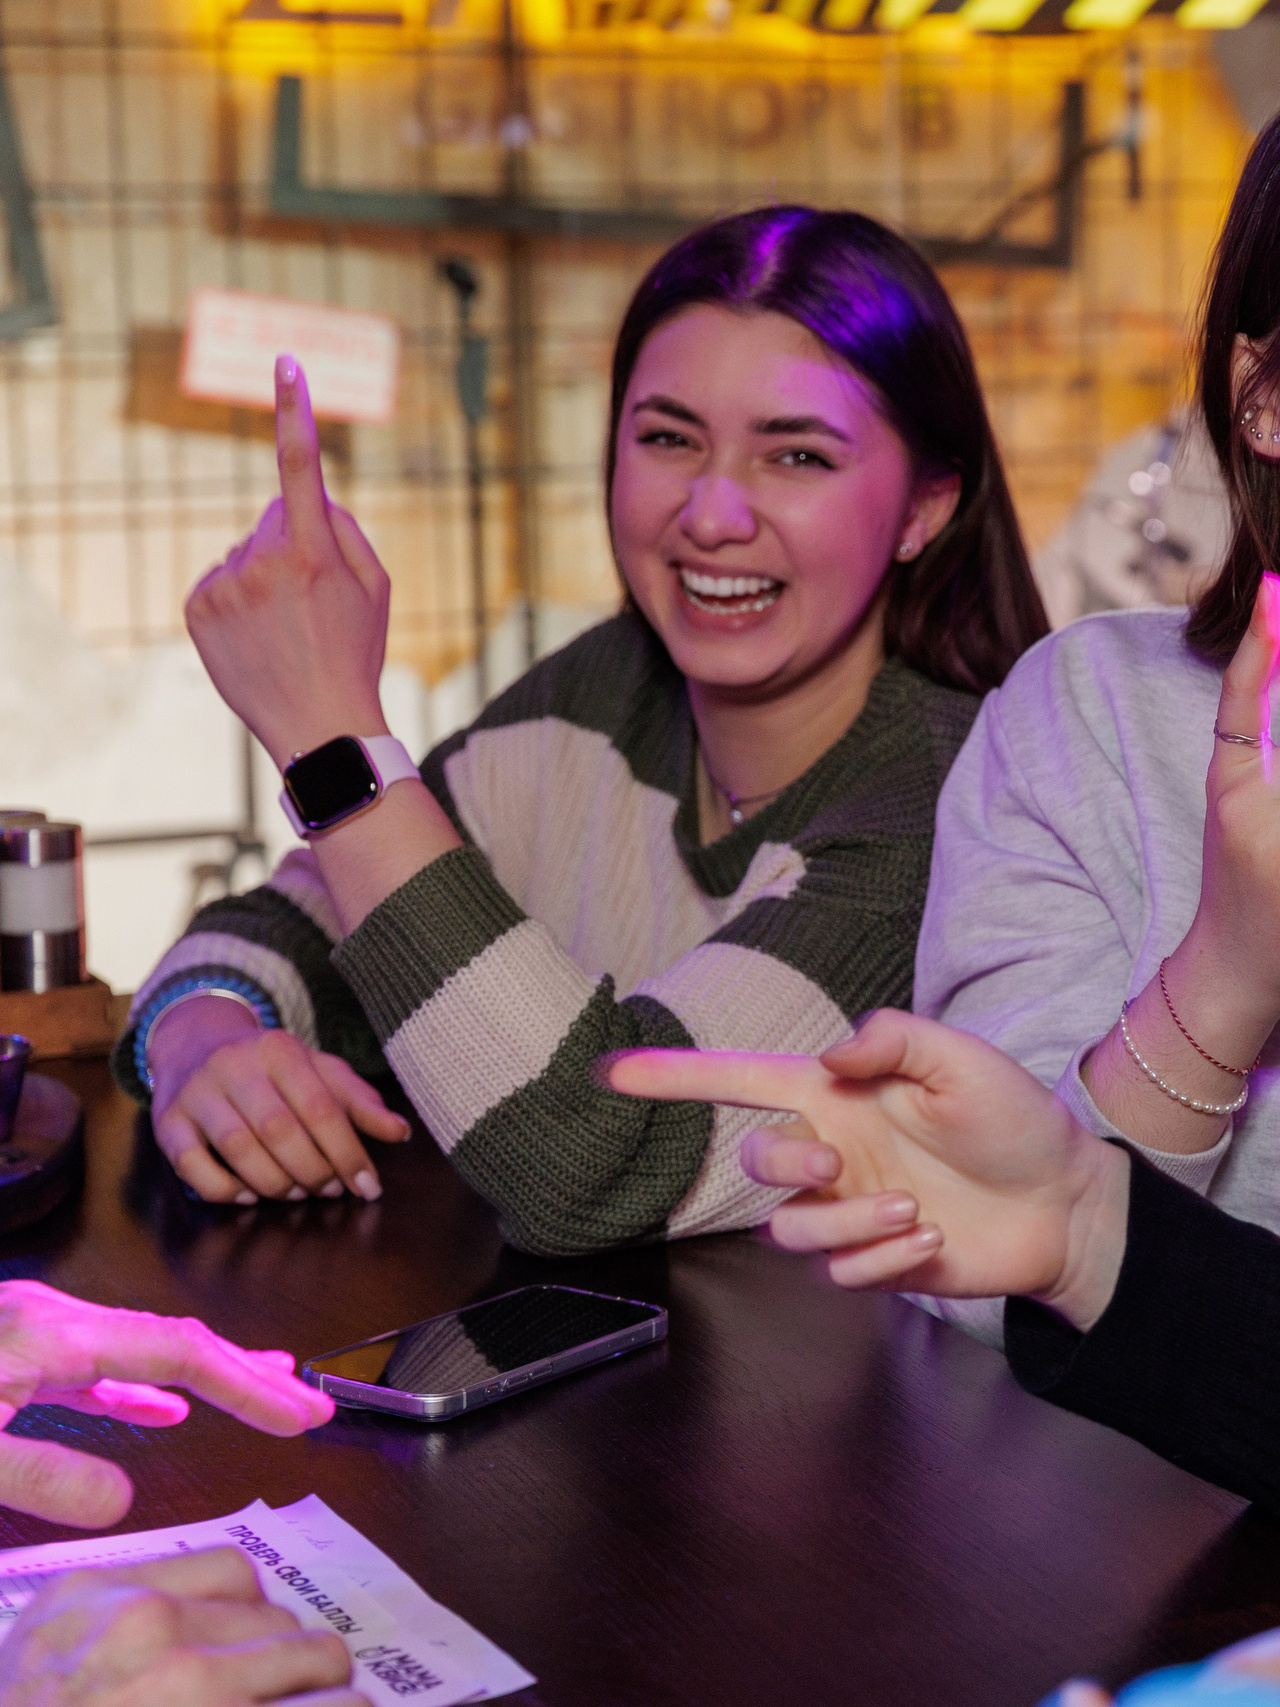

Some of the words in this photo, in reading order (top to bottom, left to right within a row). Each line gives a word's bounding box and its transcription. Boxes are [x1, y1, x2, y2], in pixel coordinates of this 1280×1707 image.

[415, 72, 961, 152] GSTROPUB
[224, 1524, 285, 1567] ПРОВЕРЬ
[274, 1565, 320, 1596] СВОИ
[305, 1594, 363, 1635] БАЛЛЫ
